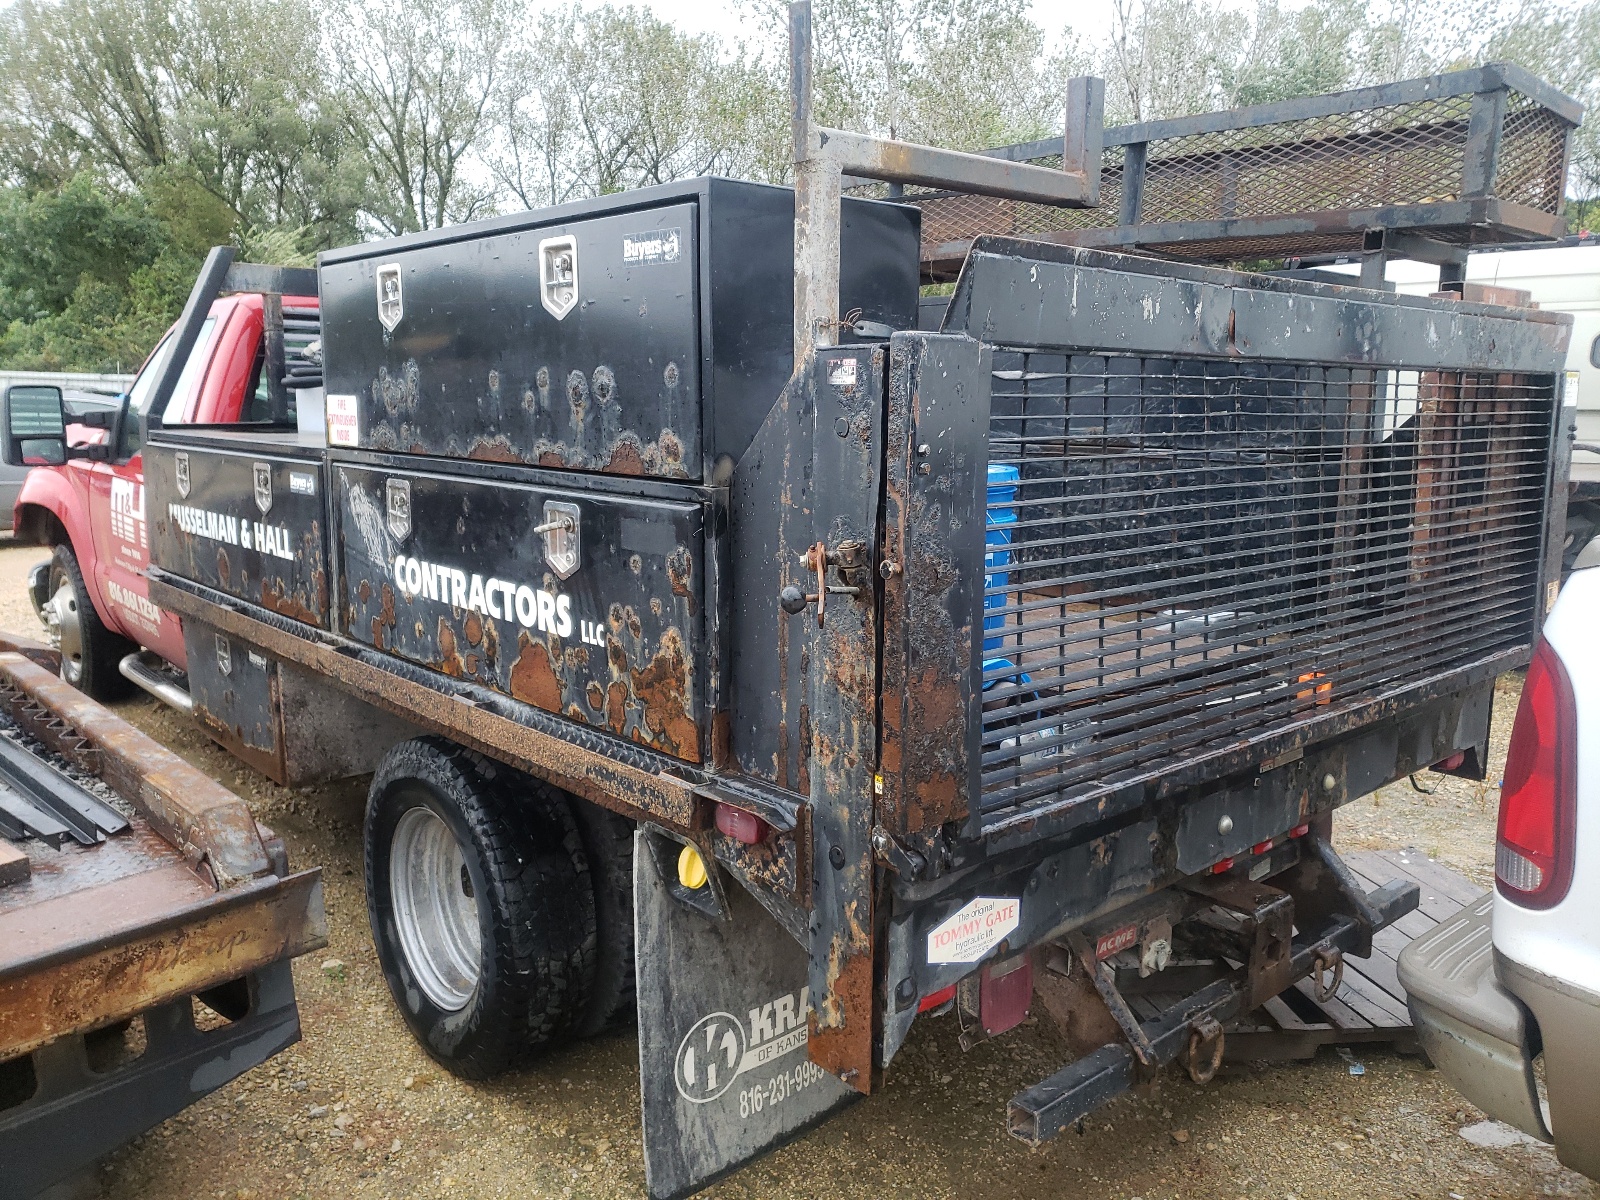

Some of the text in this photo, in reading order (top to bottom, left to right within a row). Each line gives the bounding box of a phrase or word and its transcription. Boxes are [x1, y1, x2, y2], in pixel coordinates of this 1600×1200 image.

[623, 239, 662, 260] Buyers
[240, 518, 252, 549] &
[253, 521, 294, 561] HALL
[394, 555, 605, 648] CONTRACTORS LLC
[957, 901, 995, 924] The original
[933, 904, 1014, 949] TOMMY GATE
[1098, 928, 1135, 954] ACME
[758, 1047, 773, 1062] OF
